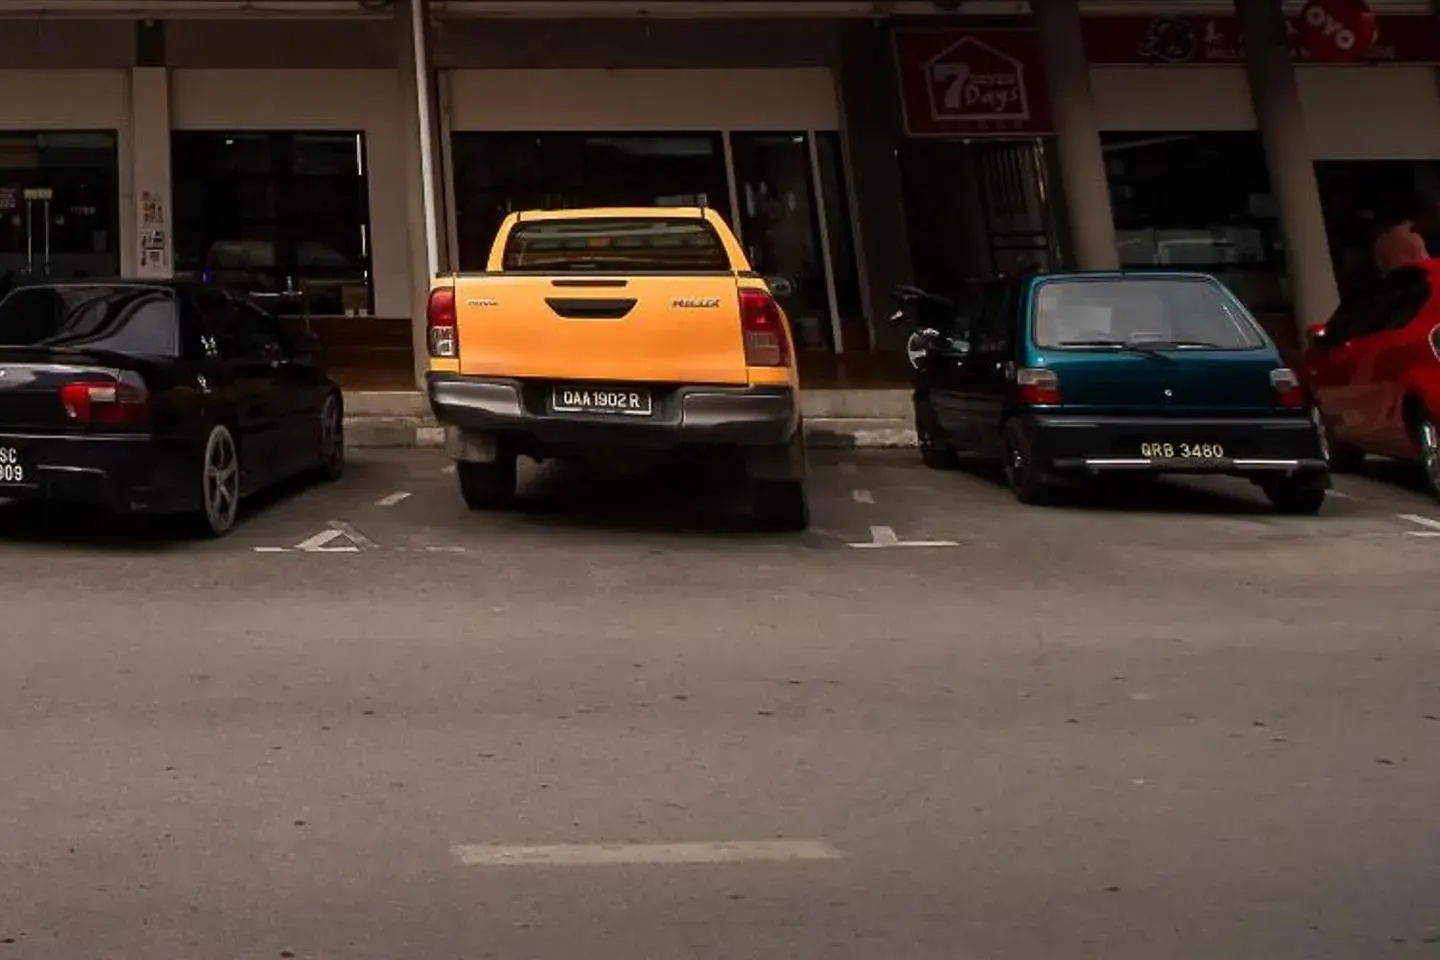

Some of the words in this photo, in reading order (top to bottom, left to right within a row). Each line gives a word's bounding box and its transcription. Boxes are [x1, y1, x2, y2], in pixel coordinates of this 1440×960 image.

[1305, 4, 1356, 50] OYO
[933, 61, 970, 109] 7
[964, 85, 1019, 112] Days
[1180, 443, 1224, 458] 3480
